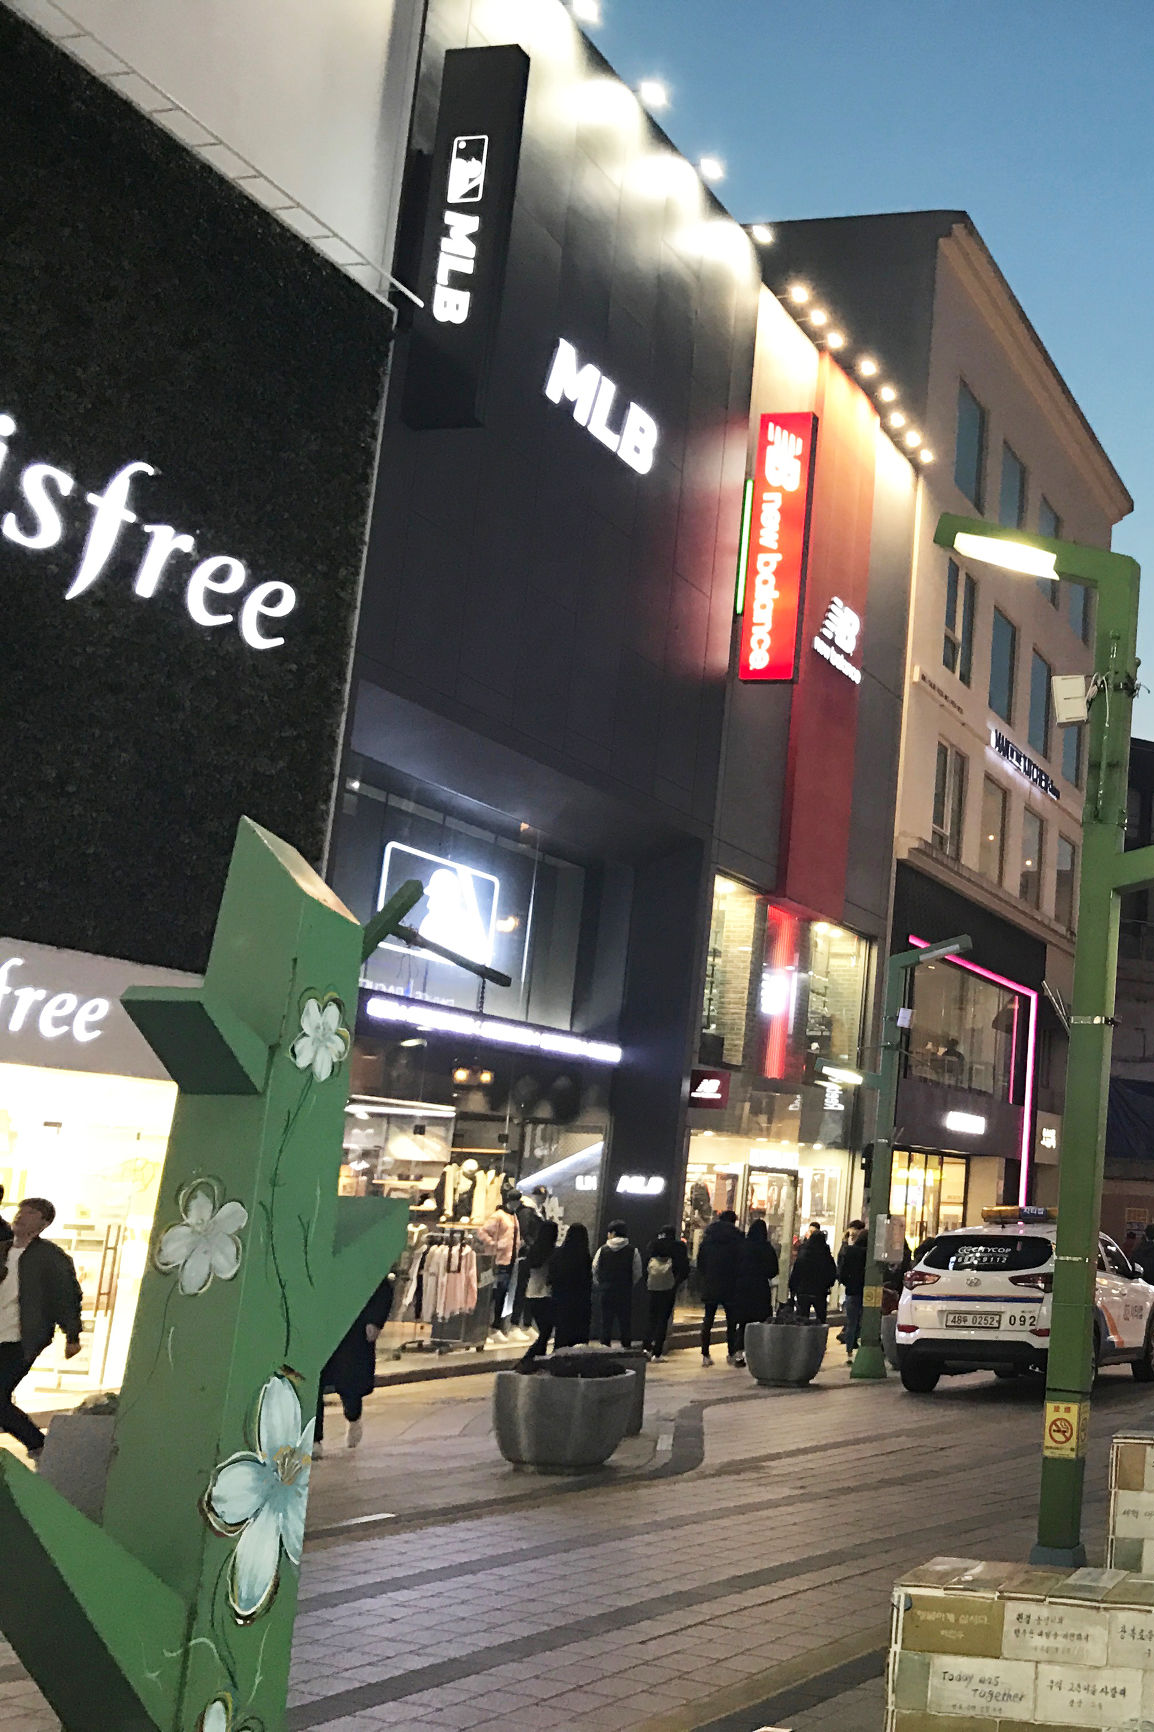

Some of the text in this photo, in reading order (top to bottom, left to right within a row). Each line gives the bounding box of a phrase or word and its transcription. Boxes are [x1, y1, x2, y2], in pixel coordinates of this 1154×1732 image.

[433, 209, 480, 325] MLB
[544, 337, 661, 475] MLB
[0, 414, 297, 650] sfree
[749, 492, 783, 671] new balance
[971, 1315, 995, 1326] 0252
[1008, 1314, 1037, 1327] 092
[942, 1671, 974, 1688] Today
